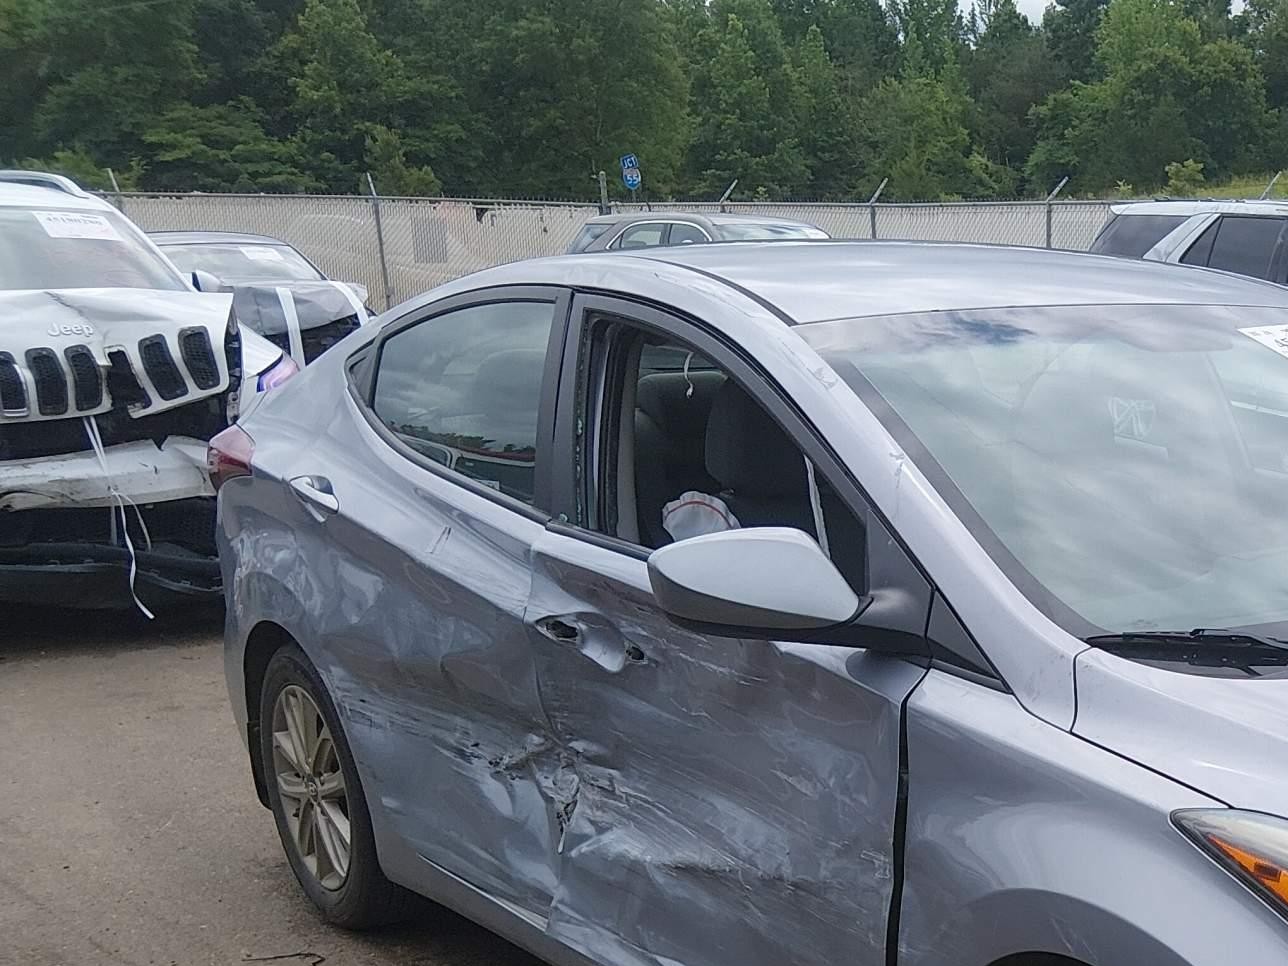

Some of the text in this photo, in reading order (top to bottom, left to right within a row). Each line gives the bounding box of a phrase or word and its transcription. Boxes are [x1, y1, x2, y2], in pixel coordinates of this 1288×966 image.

[623, 157, 636, 168] JCT
[626, 174, 639, 184] 55
[48, 321, 93, 337] Jeep
